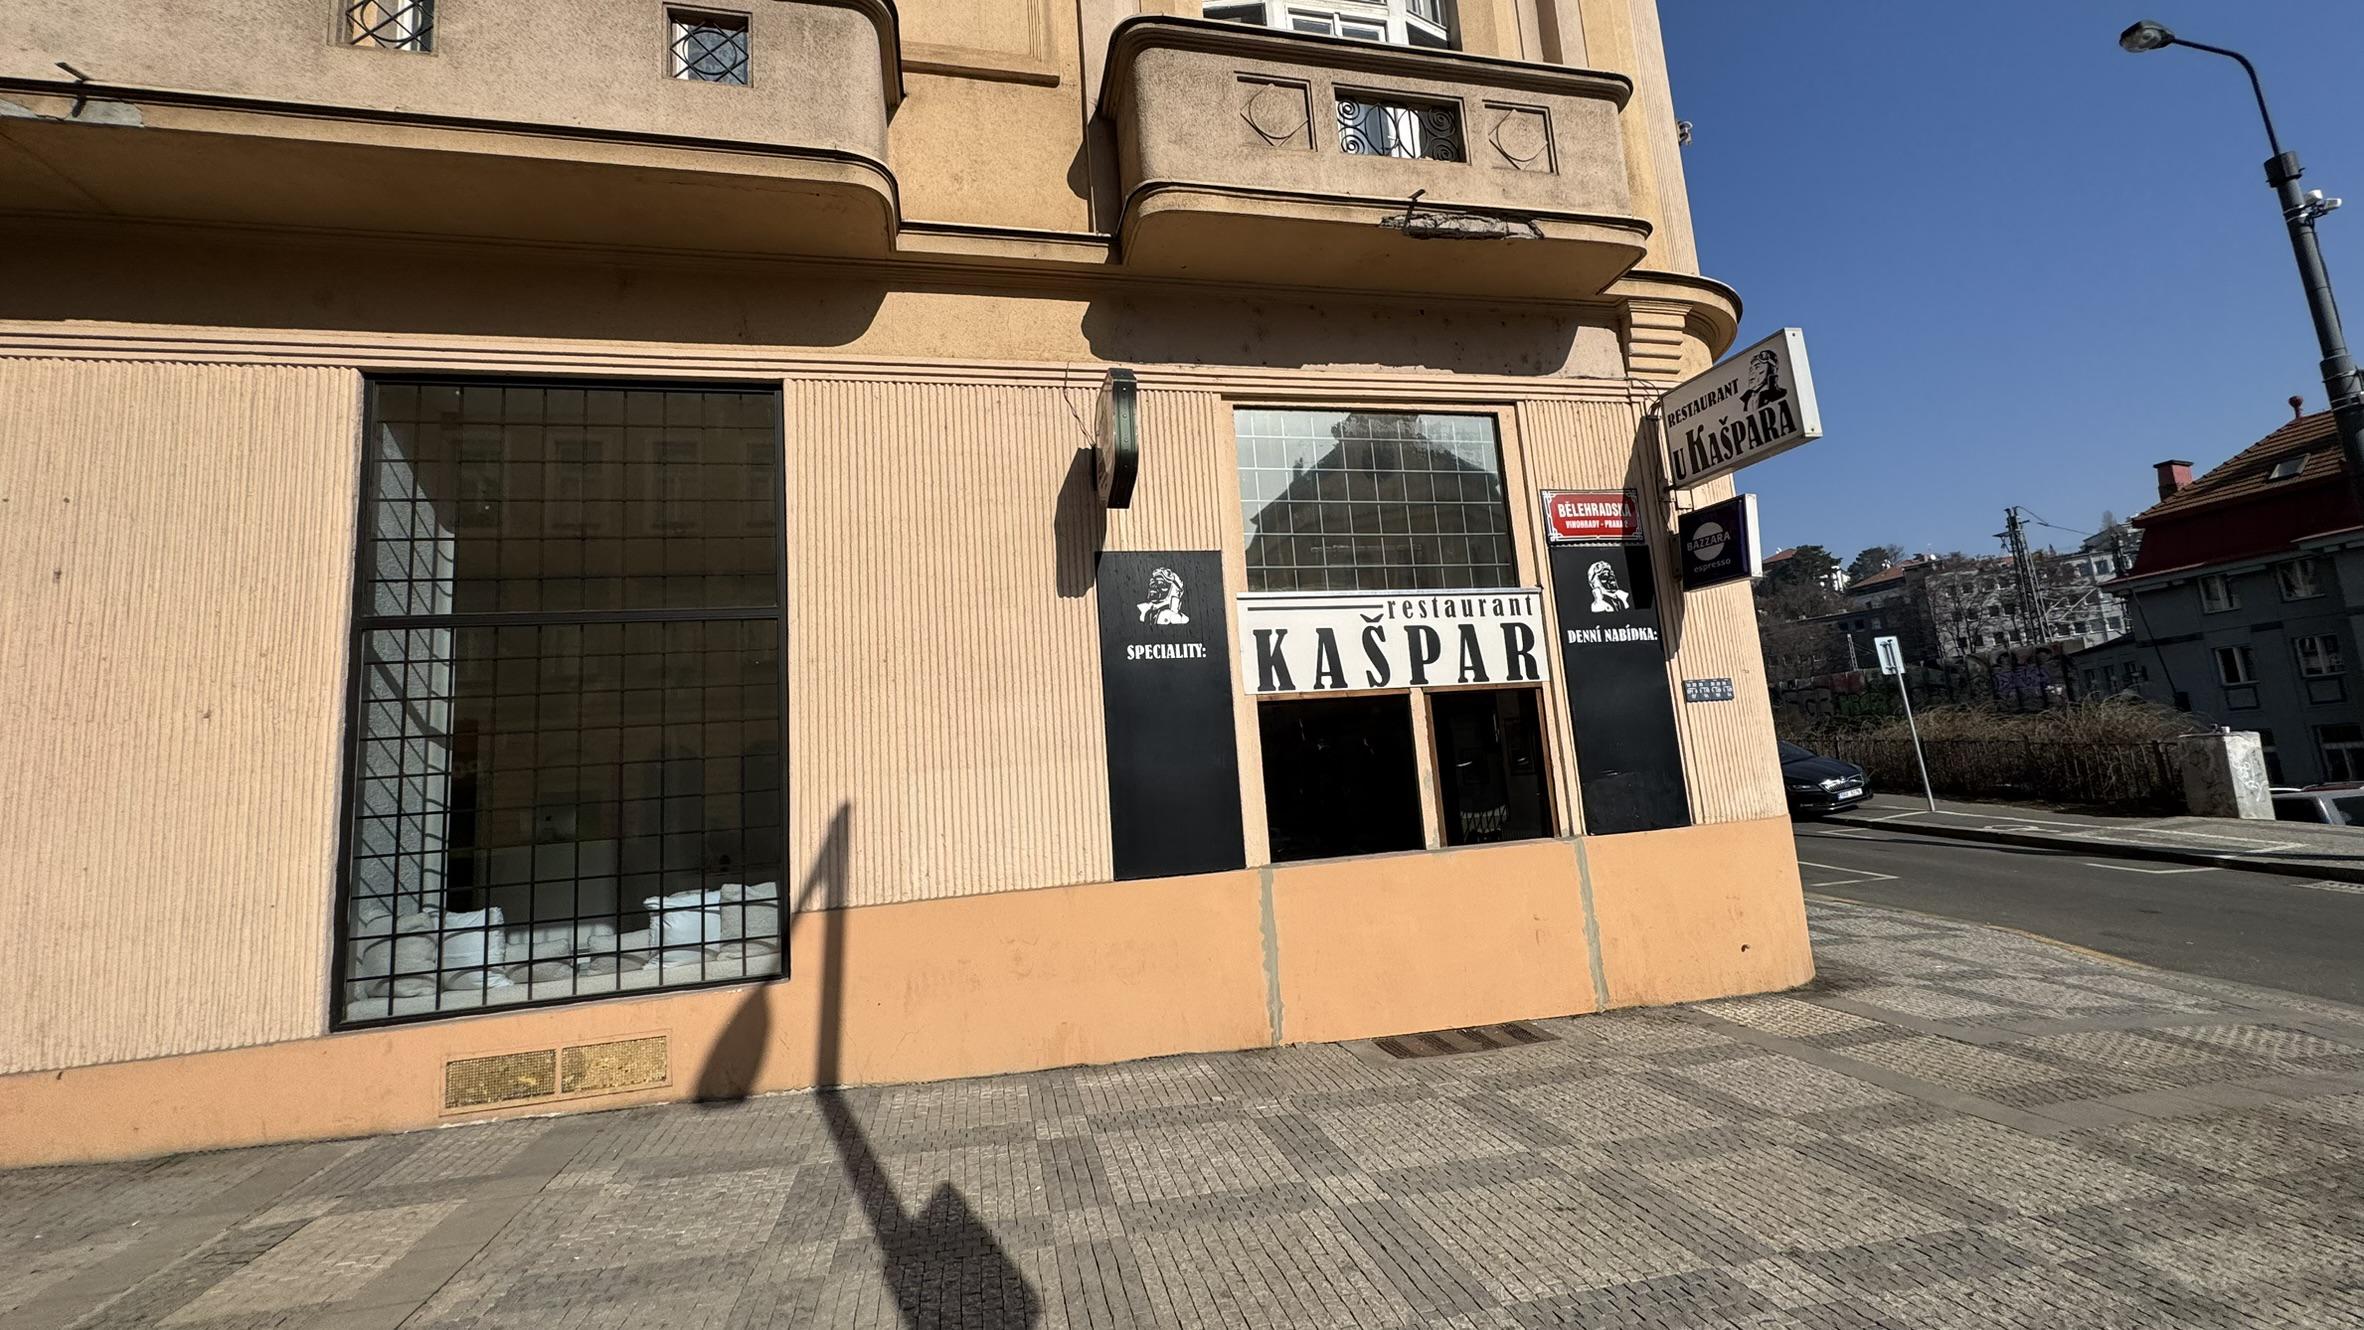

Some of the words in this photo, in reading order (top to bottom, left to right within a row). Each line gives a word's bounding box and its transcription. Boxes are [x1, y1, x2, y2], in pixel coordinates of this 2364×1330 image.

[1667, 378, 1739, 428] RESTAURANT
[1673, 448, 1687, 480] U
[1685, 400, 1797, 475] KAŠPARA
[1565, 519, 1600, 529] VINOHRADY
[1605, 519, 1623, 529] PRAHA
[1686, 531, 1732, 552] BAZZARA
[1694, 558, 1732, 573] espresso
[1387, 595, 1533, 620] restaurant
[1567, 626, 1602, 644] DENNÍ
[1604, 624, 1658, 642] NABÍDKA:
[1126, 643, 1207, 660] SPECIALITY:
[1252, 613, 1540, 692] KAŠPAR
